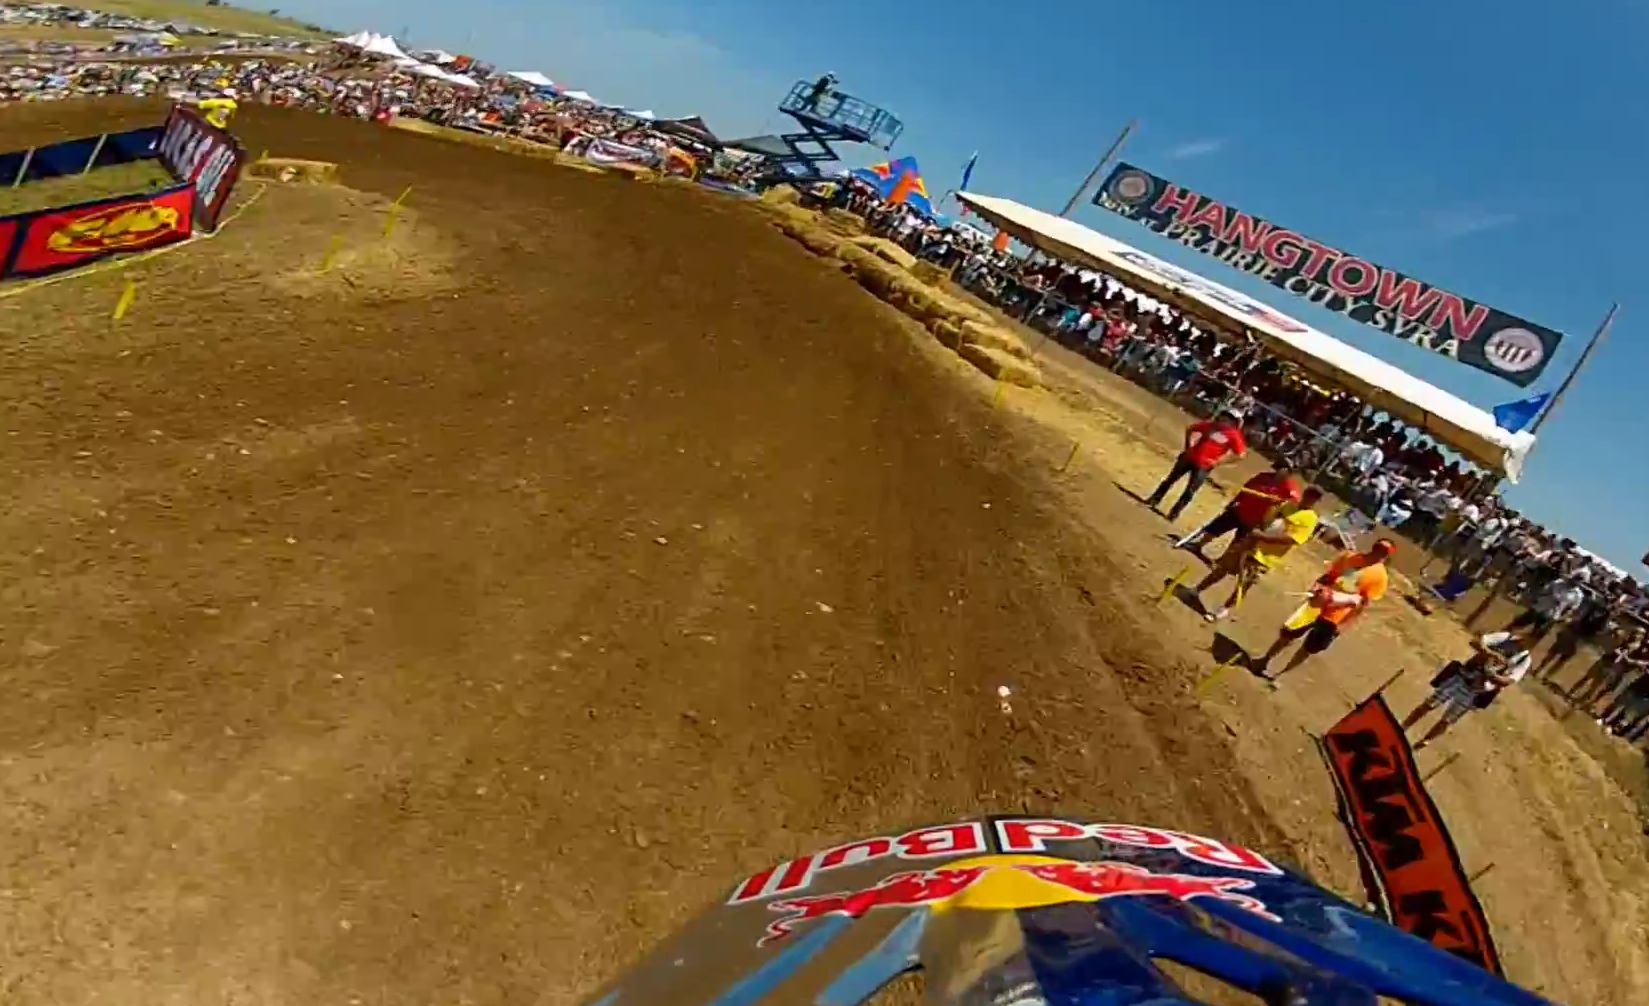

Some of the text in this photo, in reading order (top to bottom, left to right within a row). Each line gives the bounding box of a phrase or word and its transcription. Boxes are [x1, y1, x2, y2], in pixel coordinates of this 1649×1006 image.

[1155, 184, 1490, 341] HANGTOWN
[1159, 221, 1280, 283] PRAIRIE
[1284, 275, 1366, 319] CITY
[1367, 306, 1460, 358] SVRA
[727, 819, 1285, 904] Red Bull
[1328, 729, 1424, 870] KTM
